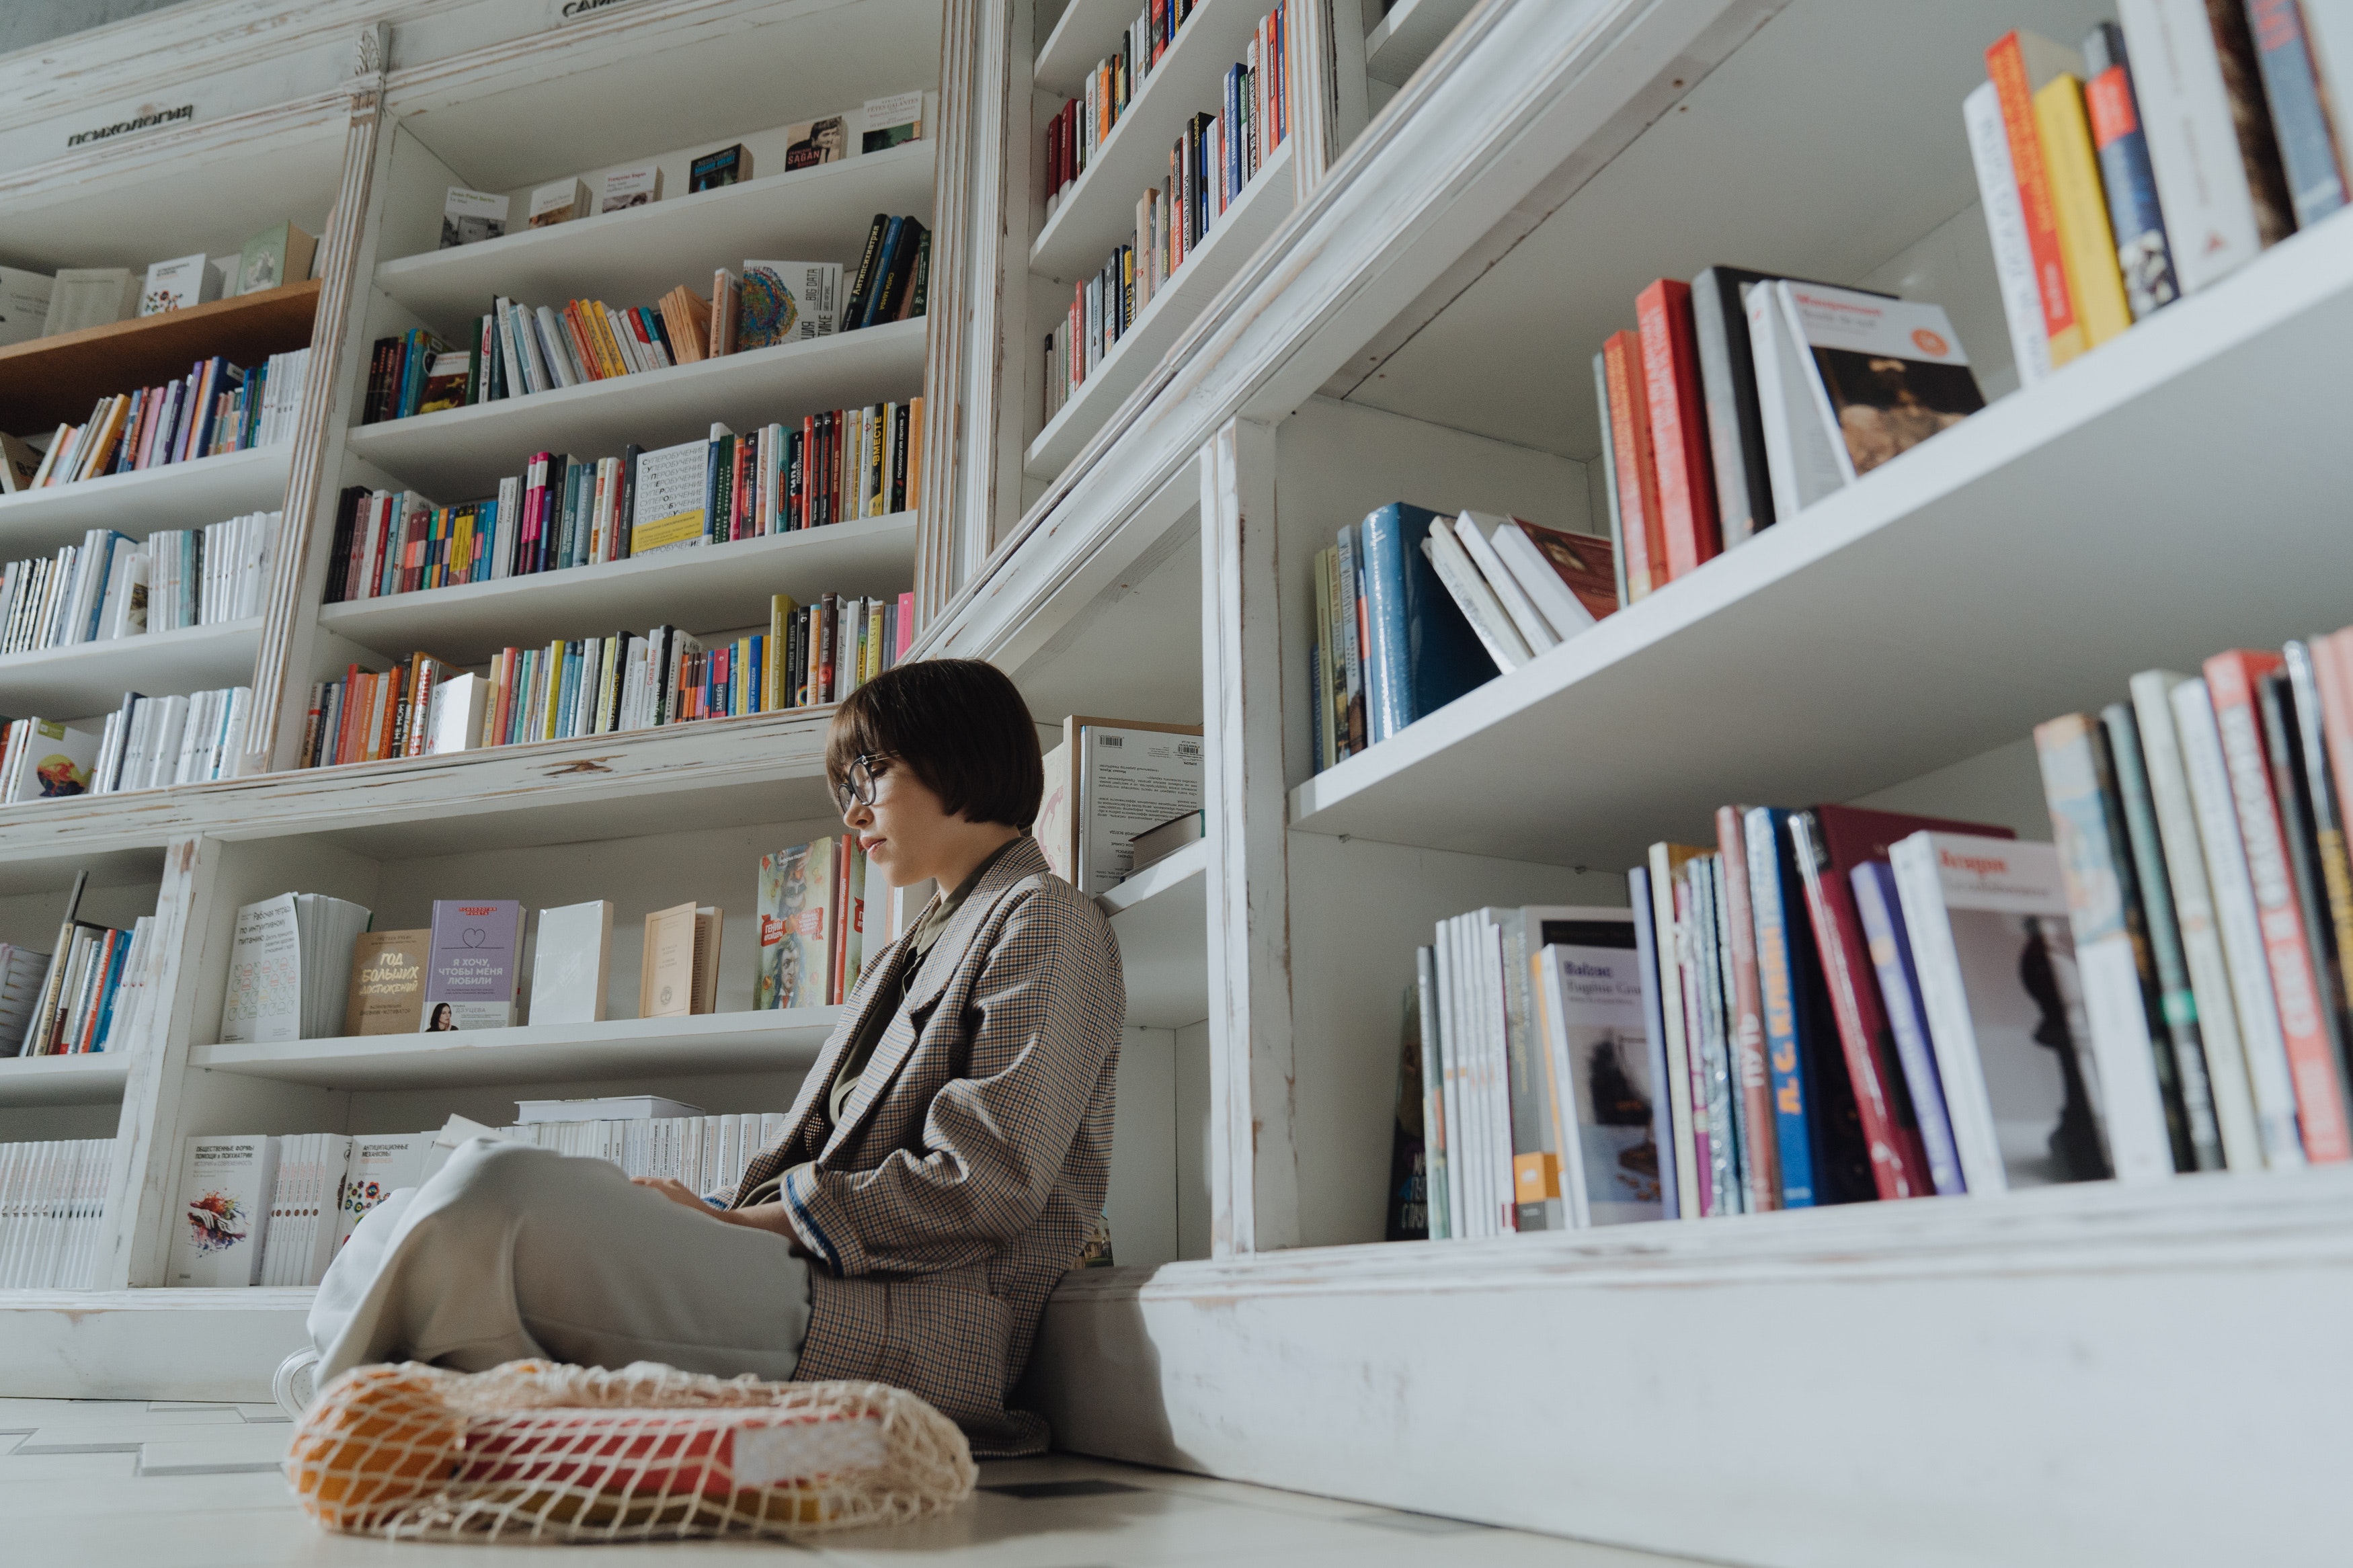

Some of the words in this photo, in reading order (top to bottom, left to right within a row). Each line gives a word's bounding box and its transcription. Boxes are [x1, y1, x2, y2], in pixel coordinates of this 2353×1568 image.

[1249, 136, 1255, 149] ИЗ
[787, 151, 820, 165] SAGAN
[854, 225, 880, 296] Антипсихиатрия
[806, 269, 817, 287] DATA
[886, 272, 895, 286] СИЛА
[806, 287, 817, 302] BIG
[879, 286, 891, 311] МИФА
[898, 419, 906, 440] ЛЕНТЯЯ
[641, 454, 705, 474] СУПЕРОБУЧЕНИЕ
[642, 446, 706, 466] СУПЕРОБУЧЕНИЕ
[758, 454, 768, 471] утра
[795, 441, 804, 484] ПОДСОЗНАНИЯ
[895, 441, 905, 479] ПСИХОЛОГИЯ
[641, 462, 705, 482] СУПЕРОБУЧЕНИЕ
[641, 471, 705, 491] СУПЕРОБУЧЕНИЕ
[756, 472, 766, 491] Магия
[581, 483, 590, 509] ТРЕВОГИ
[639, 487, 703, 507] СУПЕРОБУЧЕНИЕ
[640, 479, 704, 499] СУПЕРОБУЧЕНИЕ
[580, 510, 587, 519] ОТ
[639, 497, 703, 515] СУПЕРОБУЧЕНИЕ
[576, 521, 586, 553] СВОБОДА
[1343, 566, 1355, 626] НЕЧАЯННЫЙ
[775, 612, 783, 636] действия
[868, 616, 878, 653] СЧАСТЬЯ
[649, 649, 657, 667] воли
[774, 637, 782, 665] Искусство
[582, 662, 590, 680] ГОДЫ
[647, 667, 655, 686] Сила
[600, 668, 610, 694] сойти!
[762, 668, 770, 698] YOURSELF
[580, 682, 589, 710] ВАЖНЫЕ
[598, 696, 608, 713] ума
[715, 684, 724, 711] ЗАБЕЙ!
[772, 690, 780, 709] Стивен
[396, 703, 405, 723] НОЙ
[485, 696, 496, 724] MORE
[394, 724, 403, 740] НЕ
[483, 727, 492, 741] ME
[253, 910, 274, 921] Рабочая
[274, 905, 292, 917] тетрадь
[239, 926, 248, 935] по
[248, 919, 286, 934] интуитивному
[238, 934, 265, 946] питанию
[381, 952, 403, 966] ГОД
[462, 959, 491, 968] ХОЧУ,
[362, 966, 420, 983] БОЛЬШИХ
[439, 968, 475, 976] ЧТОБЫ
[476, 968, 503, 976] МЕНЯ
[1563, 960, 1613, 980] Balzac
[359, 981, 419, 996] ДОСТИЖЕНИЙ
[448, 977, 492, 985] ЛЮБИЛИ
